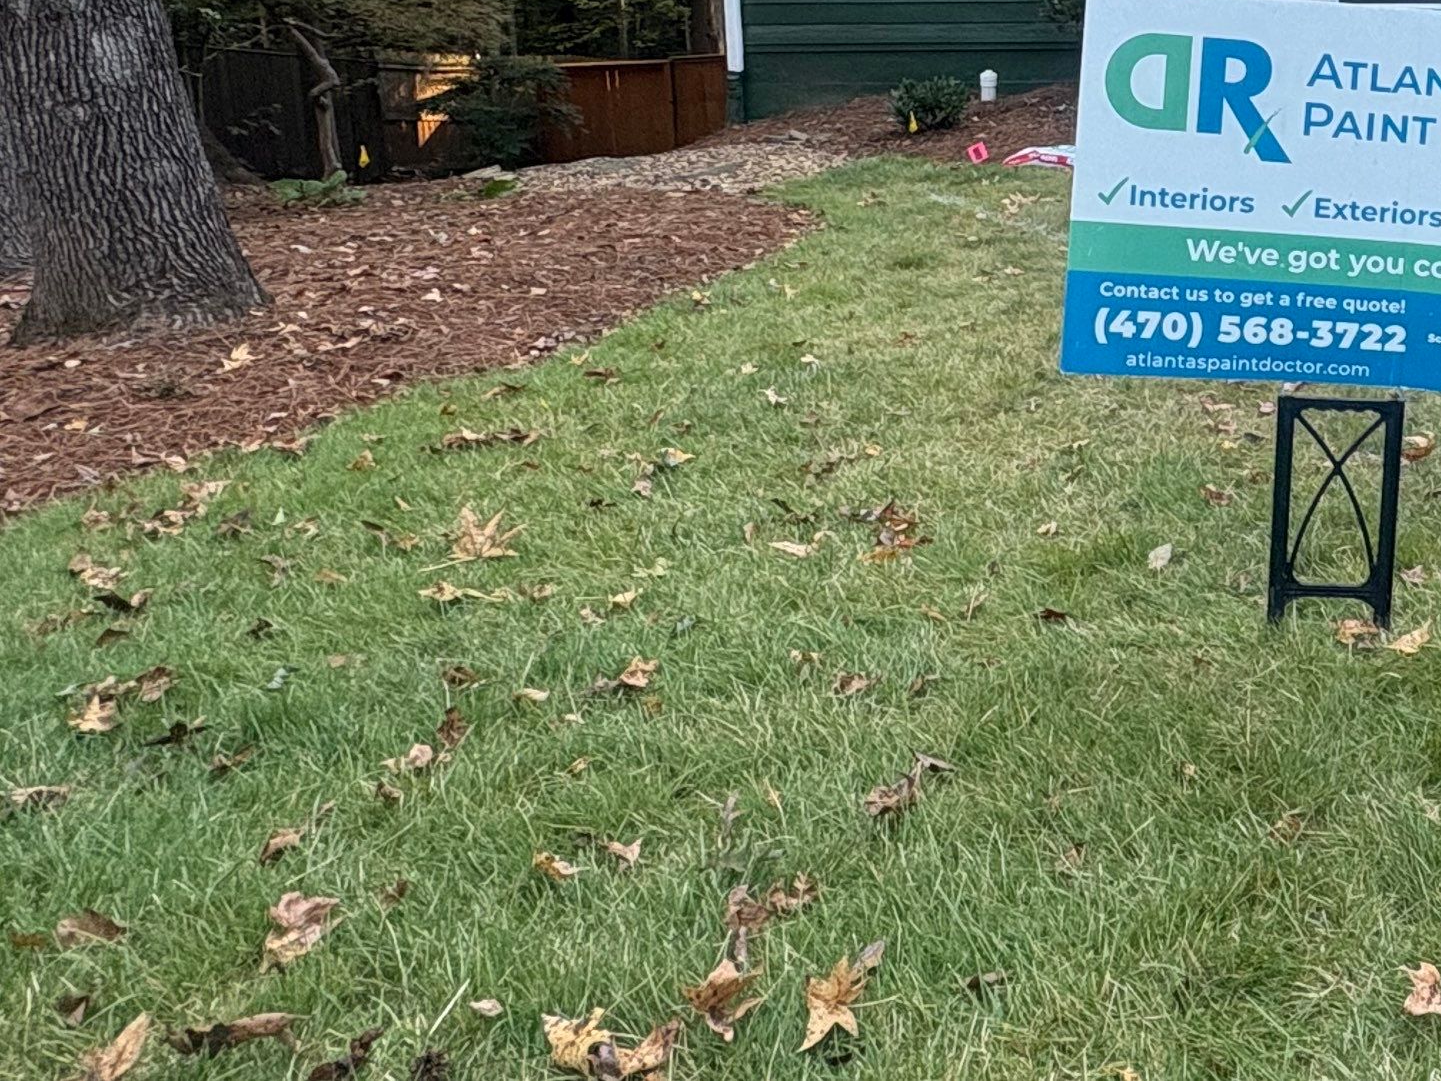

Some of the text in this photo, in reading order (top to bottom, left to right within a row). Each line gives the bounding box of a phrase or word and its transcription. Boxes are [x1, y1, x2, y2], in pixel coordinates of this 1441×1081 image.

[1303, 101, 1437, 145] PAINT
[1129, 184, 1255, 213] Interiors
[1186, 238, 1280, 265] We've
[1288, 248, 1340, 273] got
[1348, 253, 1405, 277] you
[1099, 281, 1406, 314] Contact us to get a free quote!
[1094, 307, 1407, 353] (470) 568-3722
[1125, 351, 1370, 377] atlantaspaintdoctor.com
